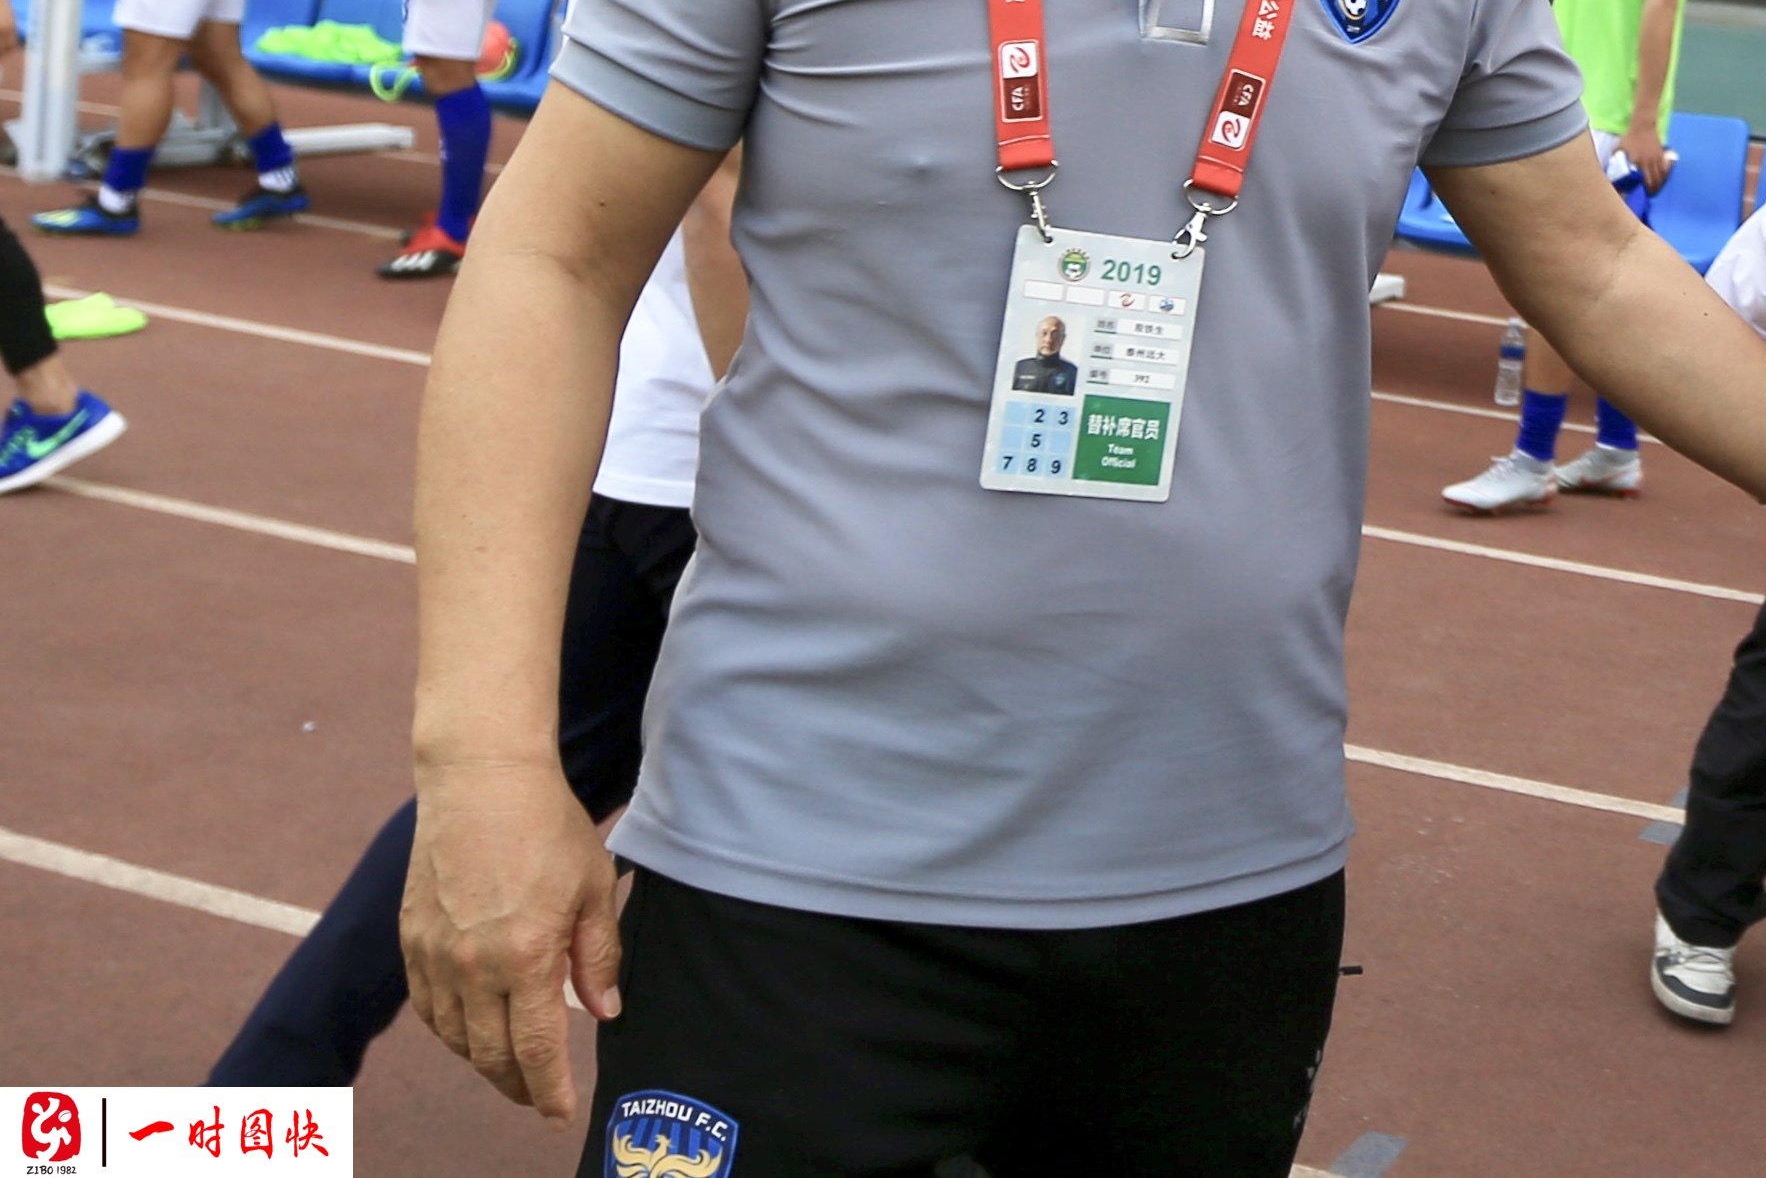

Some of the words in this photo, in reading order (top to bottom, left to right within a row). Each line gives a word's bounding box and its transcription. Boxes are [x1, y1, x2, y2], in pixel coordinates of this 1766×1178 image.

[1011, 86, 1024, 112] CFA
[1237, 83, 1254, 107] CFA
[1101, 259, 1161, 286] 2019
[1033, 409, 1045, 423] 2
[1058, 411, 1069, 425] 3
[1088, 414, 1160, 440] 替补席官员
[1031, 434, 1041, 448] 5
[1108, 443, 1134, 455] Team
[1002, 456, 1013, 470] 7
[1027, 458, 1037, 472] 8
[1050, 460, 1061, 474] 9
[1101, 456, 1137, 469] Official
[621, 1099, 694, 1122] TAIZHOU
[695, 1112, 729, 1142] F.C.
